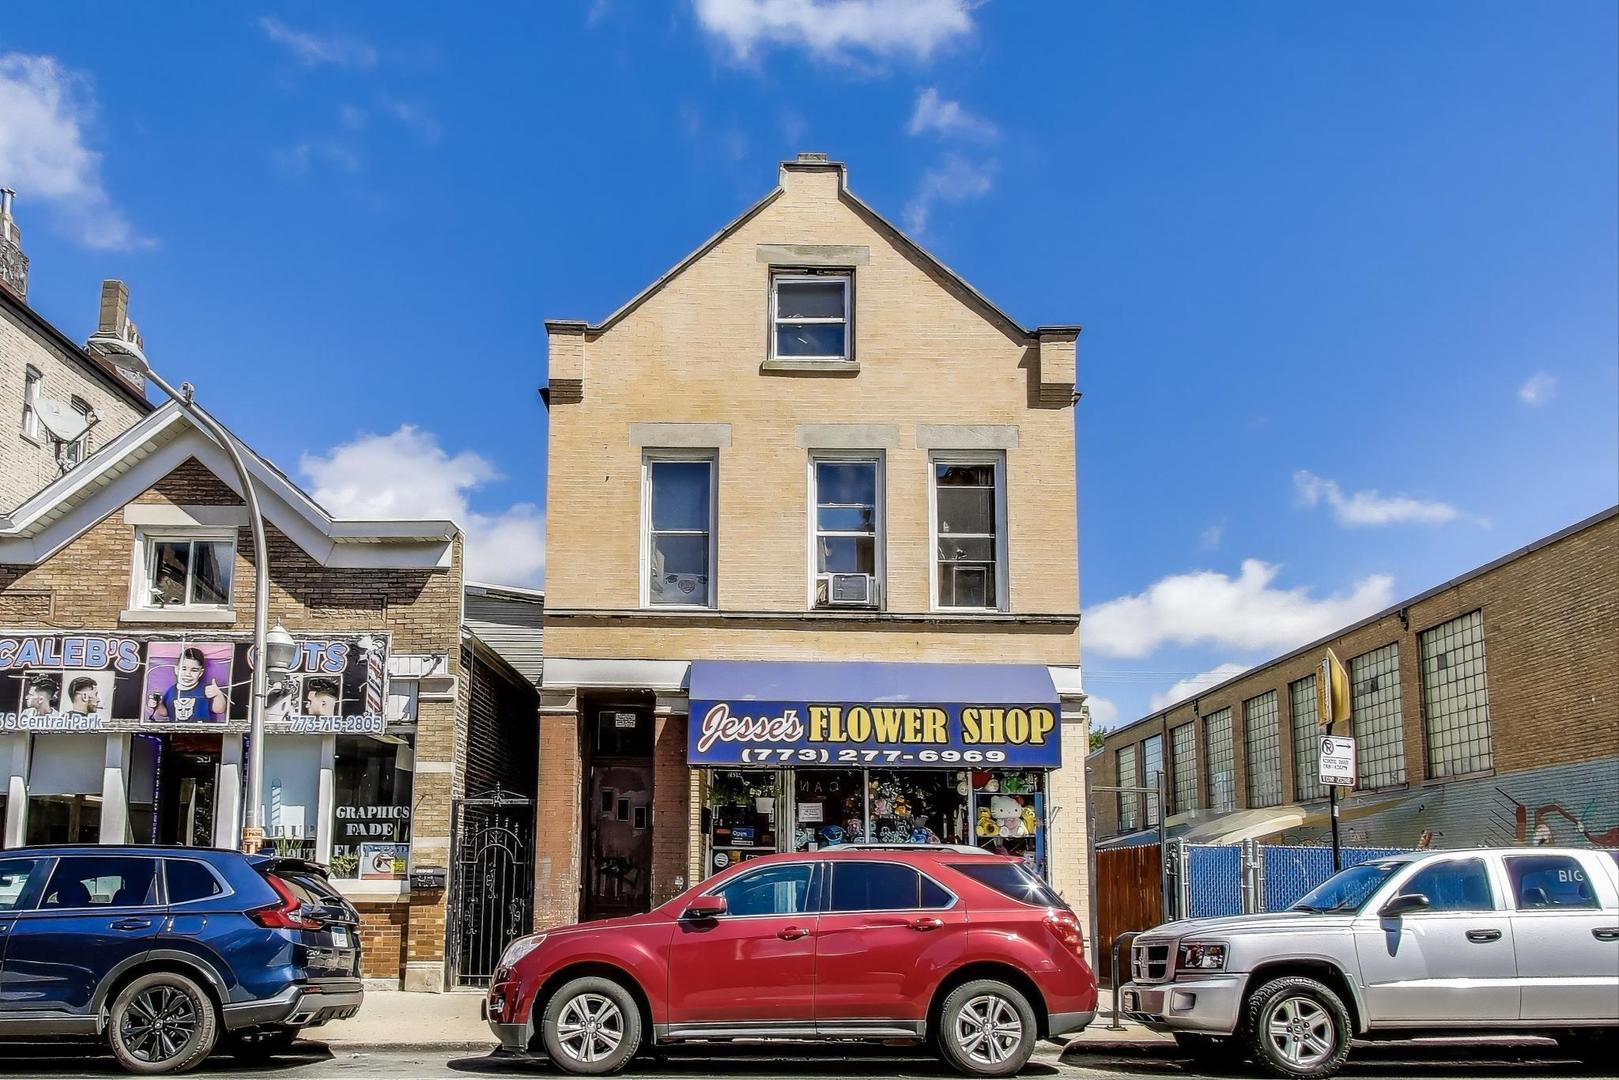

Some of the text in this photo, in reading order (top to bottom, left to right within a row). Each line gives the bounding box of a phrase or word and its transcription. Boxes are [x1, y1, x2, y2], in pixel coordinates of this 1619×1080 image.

[0, 637, 349, 673] CALEB'S TS
[20, 713, 70, 729] Central
[73, 713, 102, 729] Park
[290, 716, 382, 731] 773-715-2805
[697, 703, 1055, 752] Jesse's FLOWER SHOP
[741, 749, 1006, 762] (773) 277-6969
[336, 805, 410, 819] GRAPHICS
[345, 823, 393, 836] FADE
[1558, 869, 1584, 882] BIG
